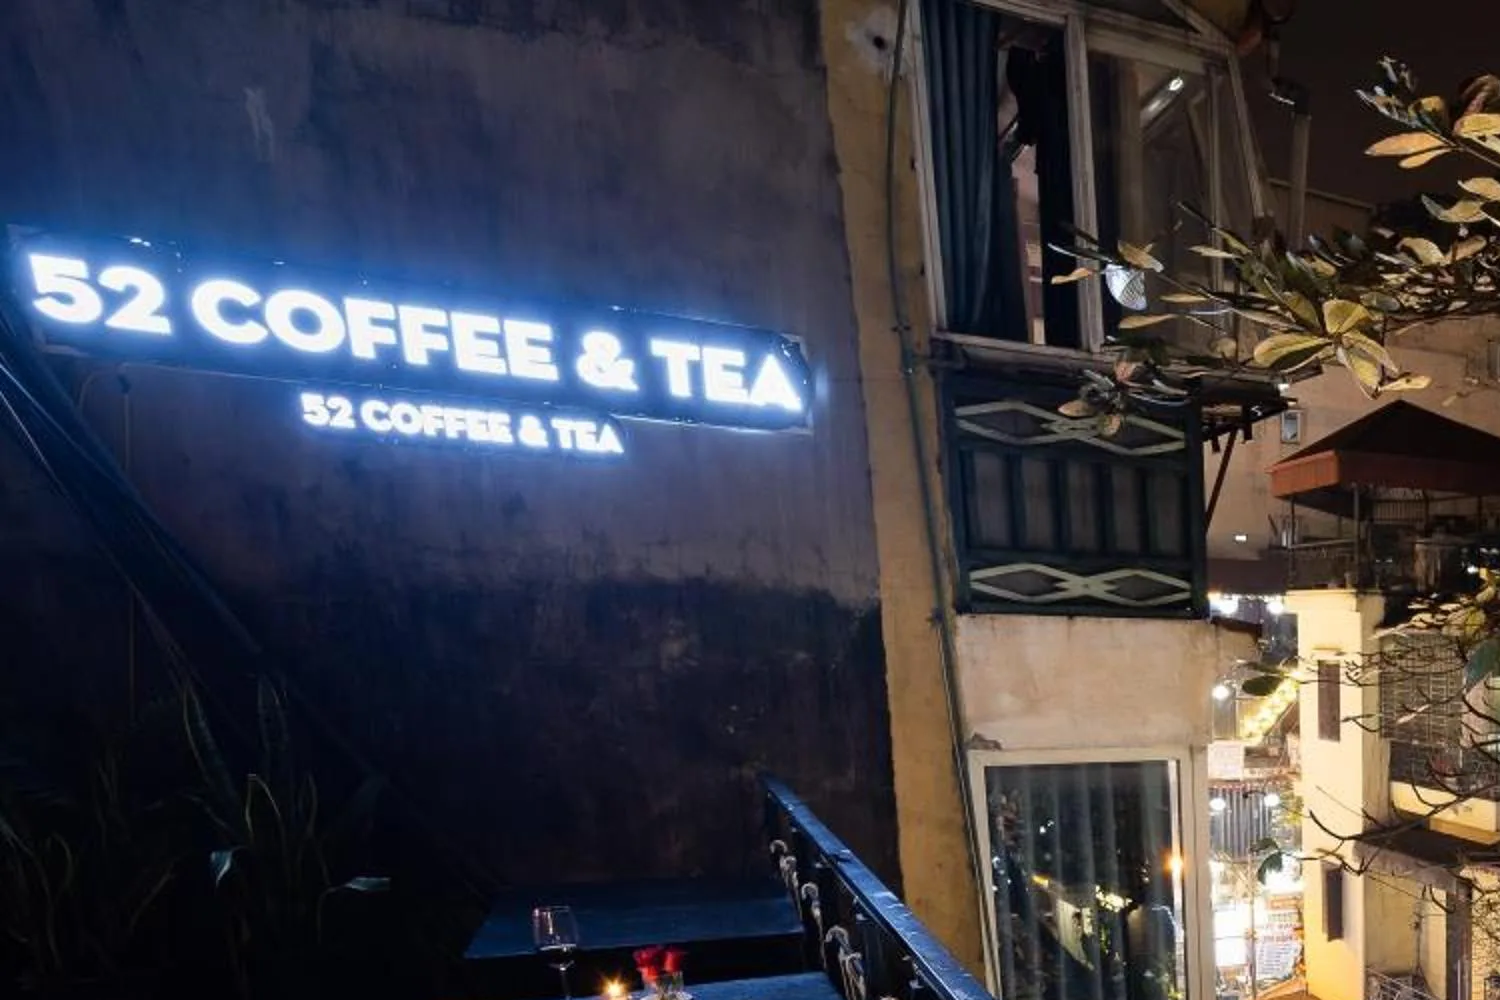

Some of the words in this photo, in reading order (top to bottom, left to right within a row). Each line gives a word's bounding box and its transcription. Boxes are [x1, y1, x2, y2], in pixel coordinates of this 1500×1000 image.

[29, 253, 171, 335] 52
[191, 279, 559, 381] COFFEE
[576, 331, 638, 391] &
[650, 339, 800, 411] TEA
[301, 394, 356, 429] 52
[361, 400, 513, 442] COFFEE
[517, 415, 548, 448] &
[551, 418, 625, 454] TEA
